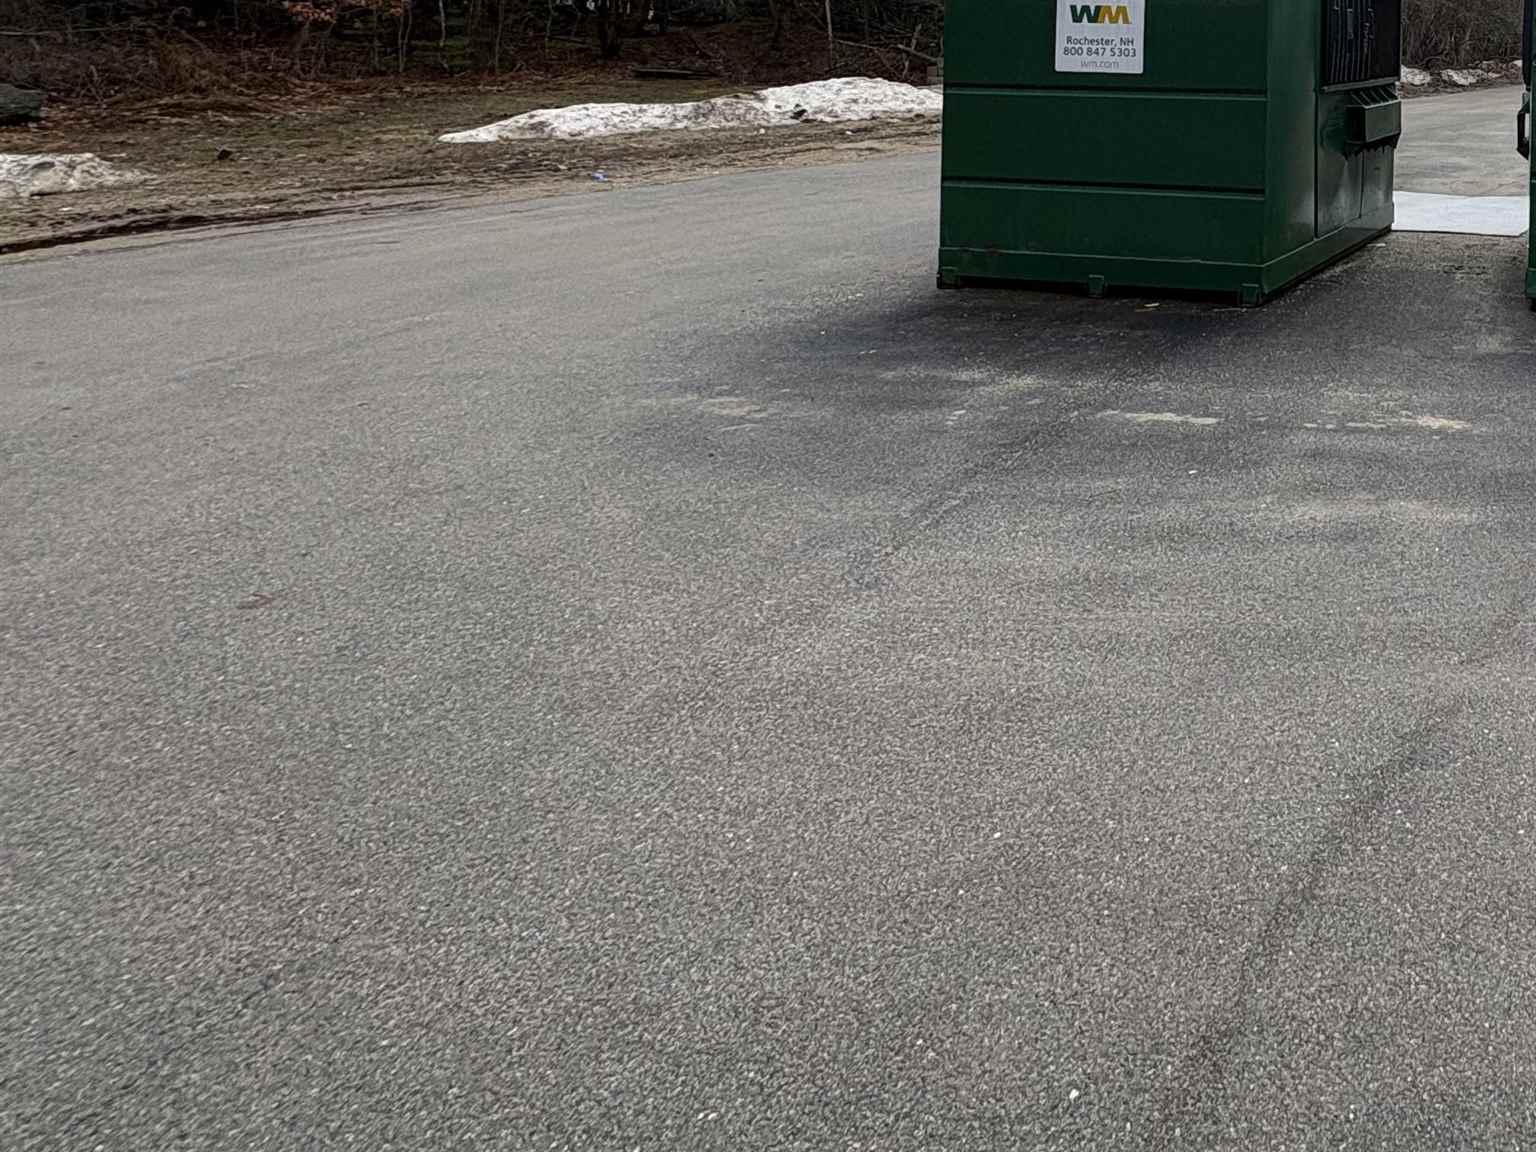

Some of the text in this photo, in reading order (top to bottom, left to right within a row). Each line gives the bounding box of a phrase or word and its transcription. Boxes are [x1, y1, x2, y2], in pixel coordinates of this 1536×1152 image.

[1070, 4, 1131, 24] WM
[1066, 36, 1134, 48] Rochester, NH
[1063, 47, 1137, 57] 800 847 5303
[1080, 60, 1120, 69] wm.com
